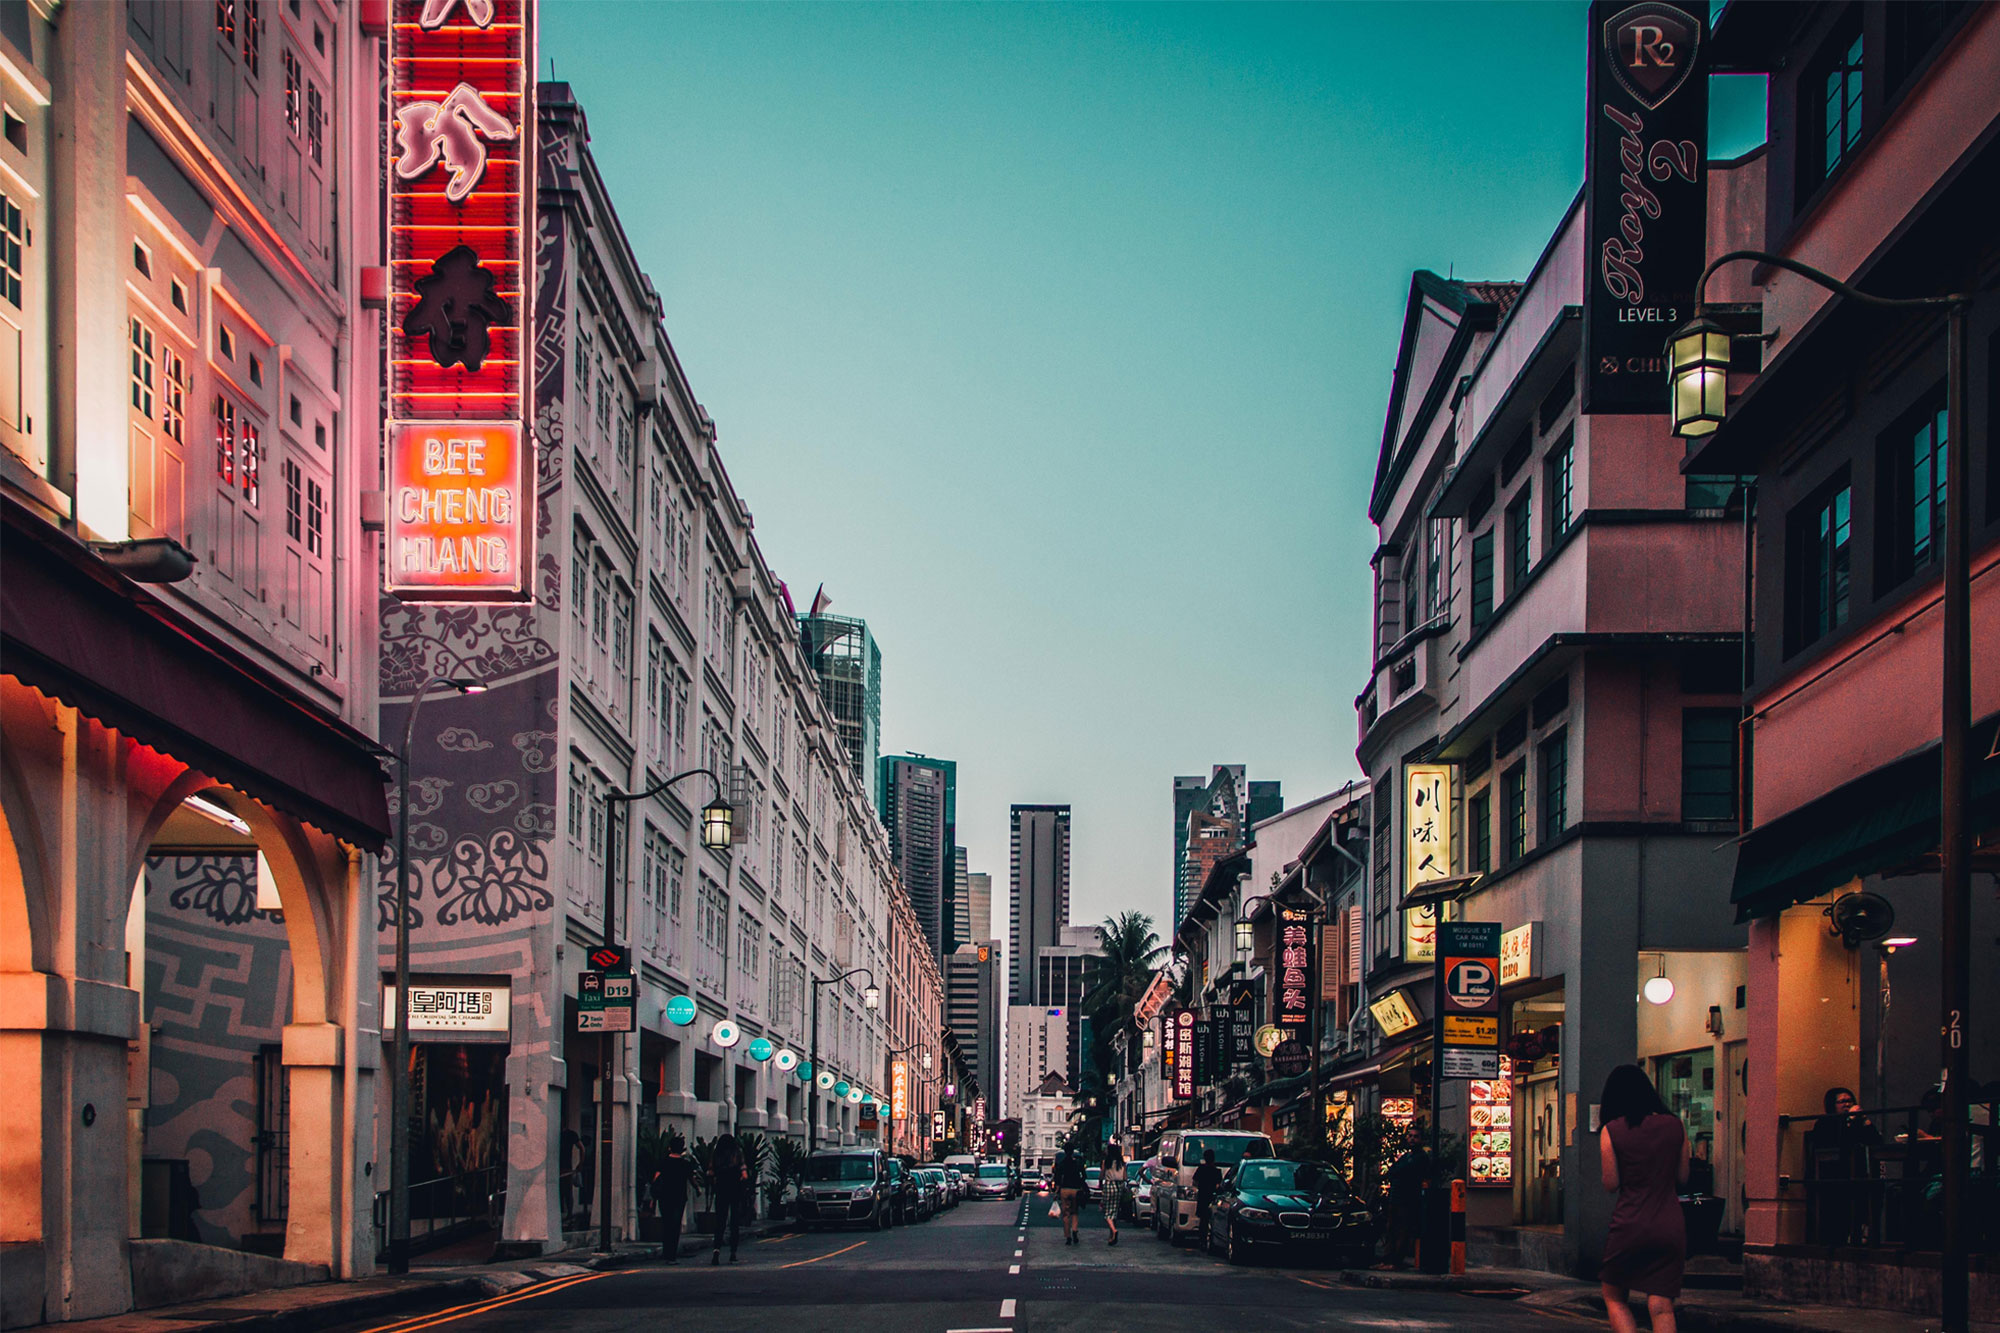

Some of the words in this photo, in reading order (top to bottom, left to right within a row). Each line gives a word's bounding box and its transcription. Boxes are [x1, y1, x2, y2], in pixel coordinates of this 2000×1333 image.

[1648, 140, 1698, 184] 2
[1602, 104, 1662, 305] Royal
[1618, 308, 1665, 323] LEVEL
[1667, 308, 1678, 323] 3
[425, 439, 486, 475] BEE
[399, 487, 512, 523] CHENG
[401, 536, 509, 573] HIANG
[1282, 925, 1307, 1010] 美蛙鱼头
[1503, 962, 1519, 978] BBQ
[1458, 965, 1490, 994] P
[584, 993, 602, 1002] Taxi
[607, 985, 629, 997] D19
[579, 1014, 590, 1028] 2
[1235, 1010, 1250, 1022] THAI
[1232, 1024, 1252, 1036] RELAX
[1476, 1027, 1496, 1035] $1.20
[1950, 1009, 1962, 1049] 20
[1236, 1038, 1249, 1051] SPA
